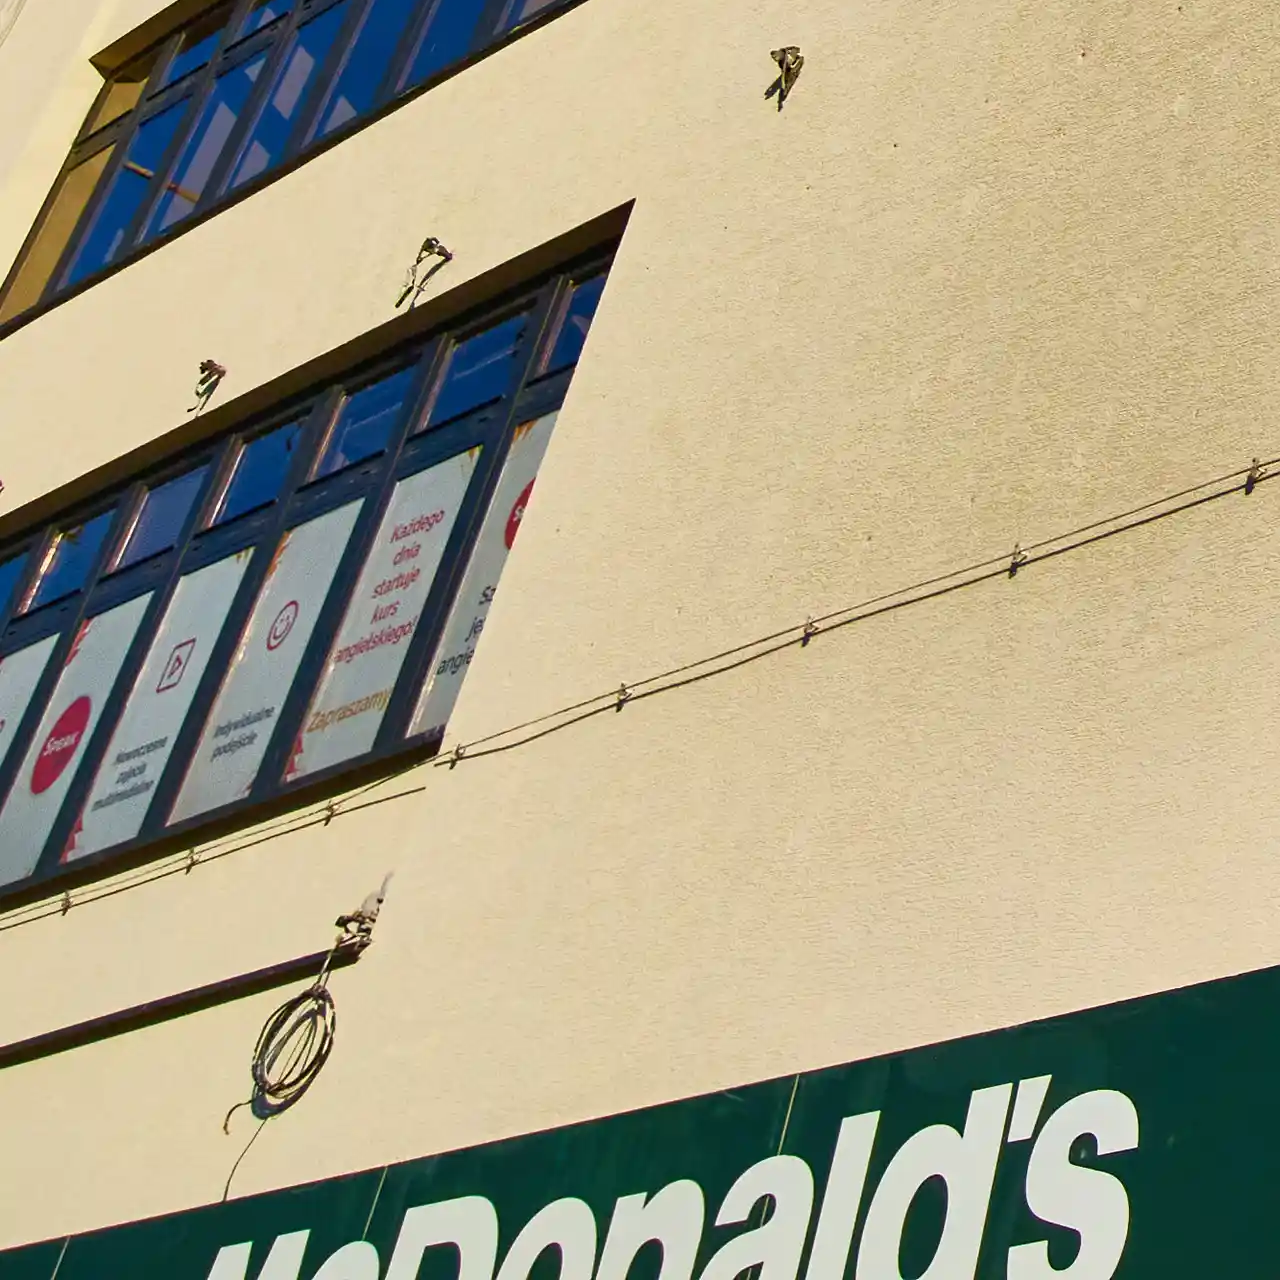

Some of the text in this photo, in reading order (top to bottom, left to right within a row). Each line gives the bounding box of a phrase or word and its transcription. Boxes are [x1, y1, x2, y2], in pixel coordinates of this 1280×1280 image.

[390, 509, 445, 543] Każdego
[393, 542, 421, 566] dnia
[371, 567, 421, 599] startuje
[370, 600, 400, 625] kurs
[207, 1074, 1139, 1280] nald's
